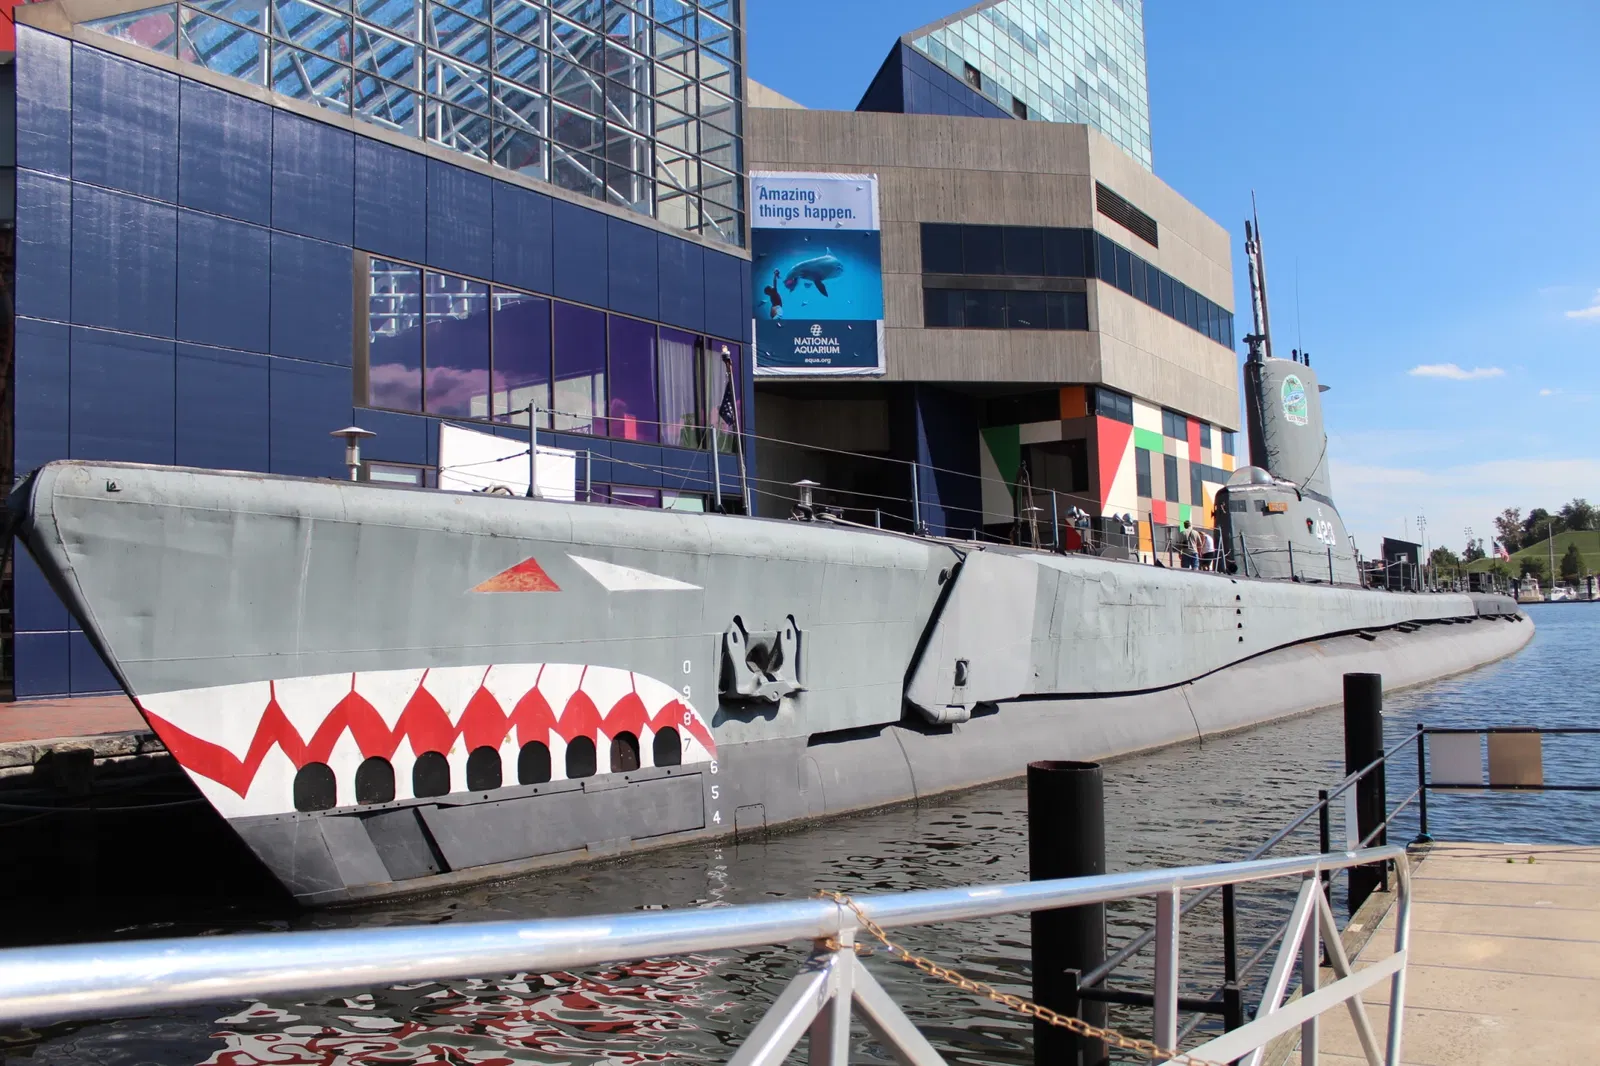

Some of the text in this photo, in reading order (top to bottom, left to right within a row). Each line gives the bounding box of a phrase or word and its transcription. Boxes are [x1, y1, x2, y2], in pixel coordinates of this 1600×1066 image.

[759, 187, 815, 203] Amazing
[759, 205, 856, 221] things happen.
[794, 337, 840, 346] NATIONAL
[794, 345, 840, 354] AQUARIUM
[683, 685, 691, 699] 9
[683, 712, 691, 725] 8
[684, 738, 692, 751] 7
[710, 760, 718, 774] 6
[711, 786, 719, 799] 5
[713, 811, 721, 824] 4
